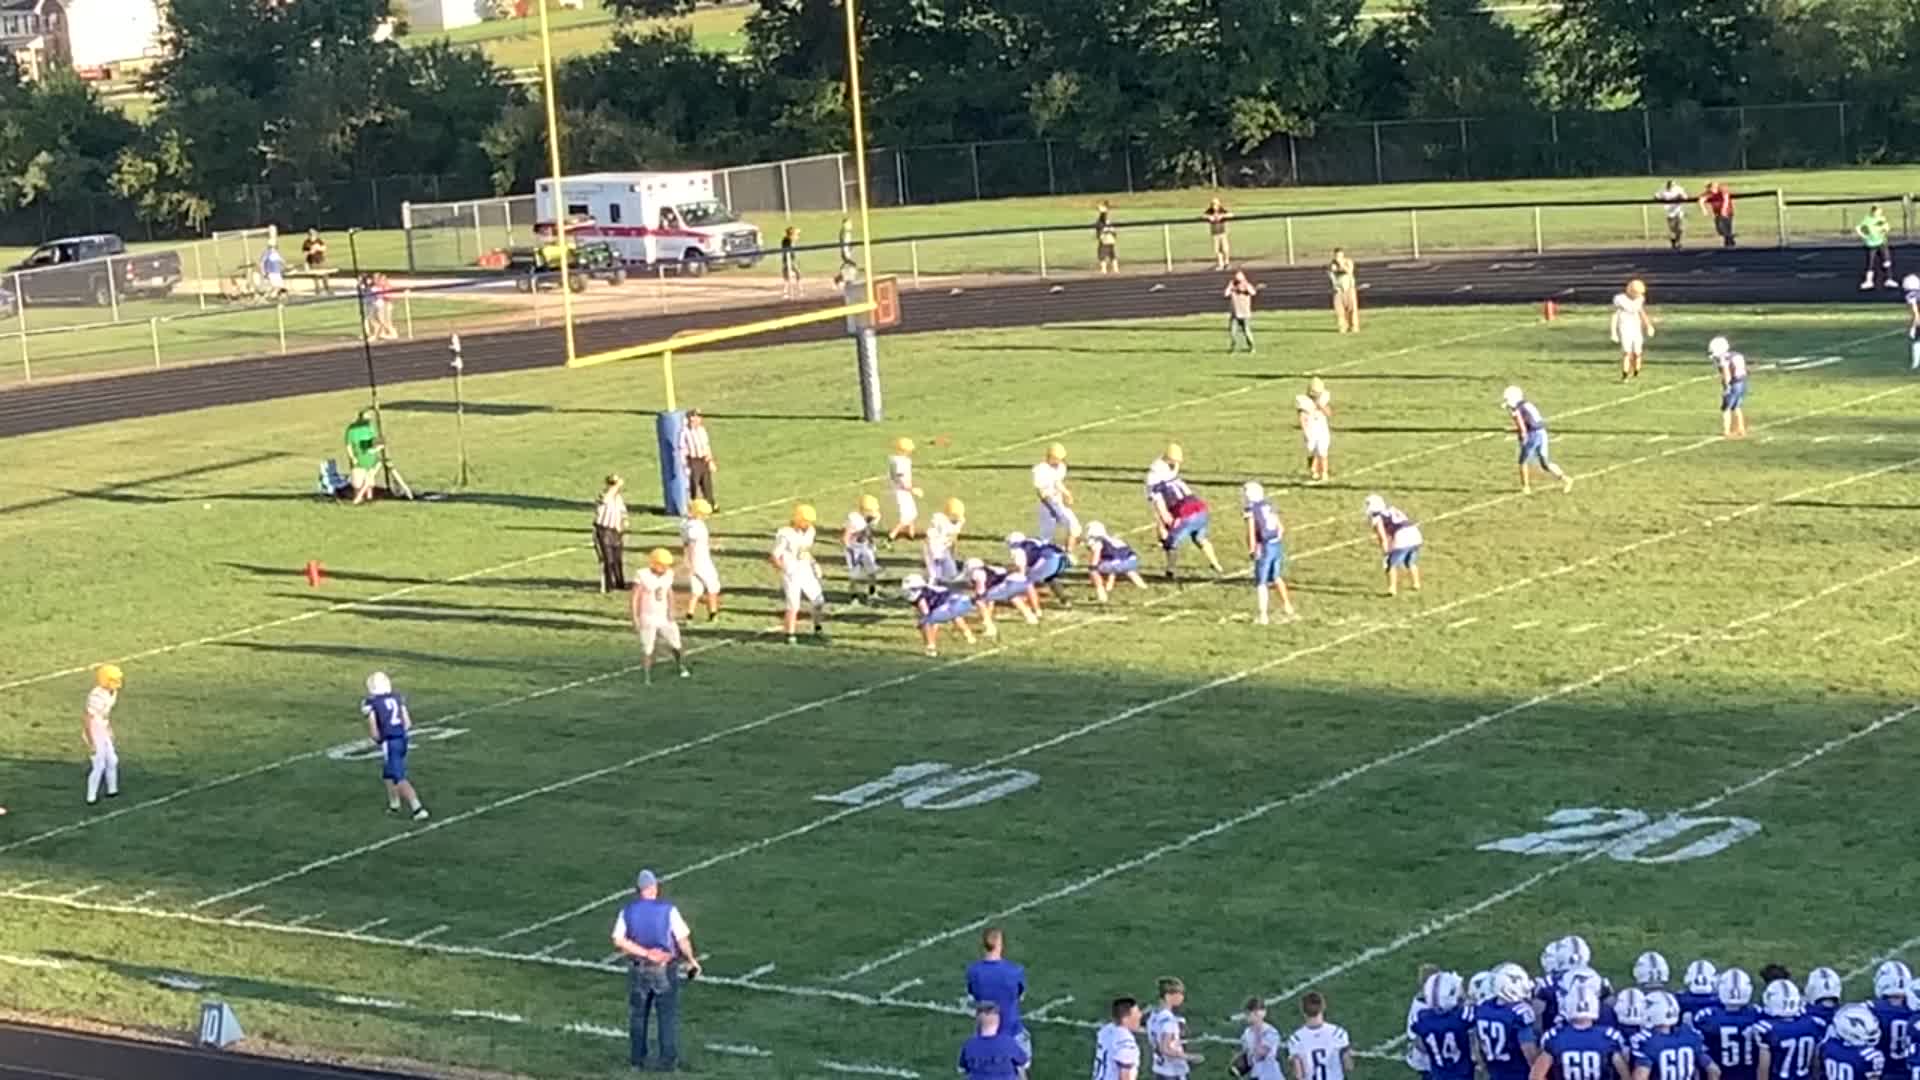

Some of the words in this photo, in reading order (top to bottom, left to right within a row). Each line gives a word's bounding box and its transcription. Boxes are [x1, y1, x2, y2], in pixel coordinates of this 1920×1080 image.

[383, 698, 402, 725] 2
[811, 761, 1041, 810] 10
[1475, 806, 1763, 864] 20
[201, 1007, 220, 1042] 10
[1476, 1019, 1512, 1062] 52
[1425, 1031, 1462, 1067] 14
[1659, 1046, 1695, 1080] 60
[1719, 1025, 1754, 1067] 51
[1779, 1035, 1816, 1079] 70
